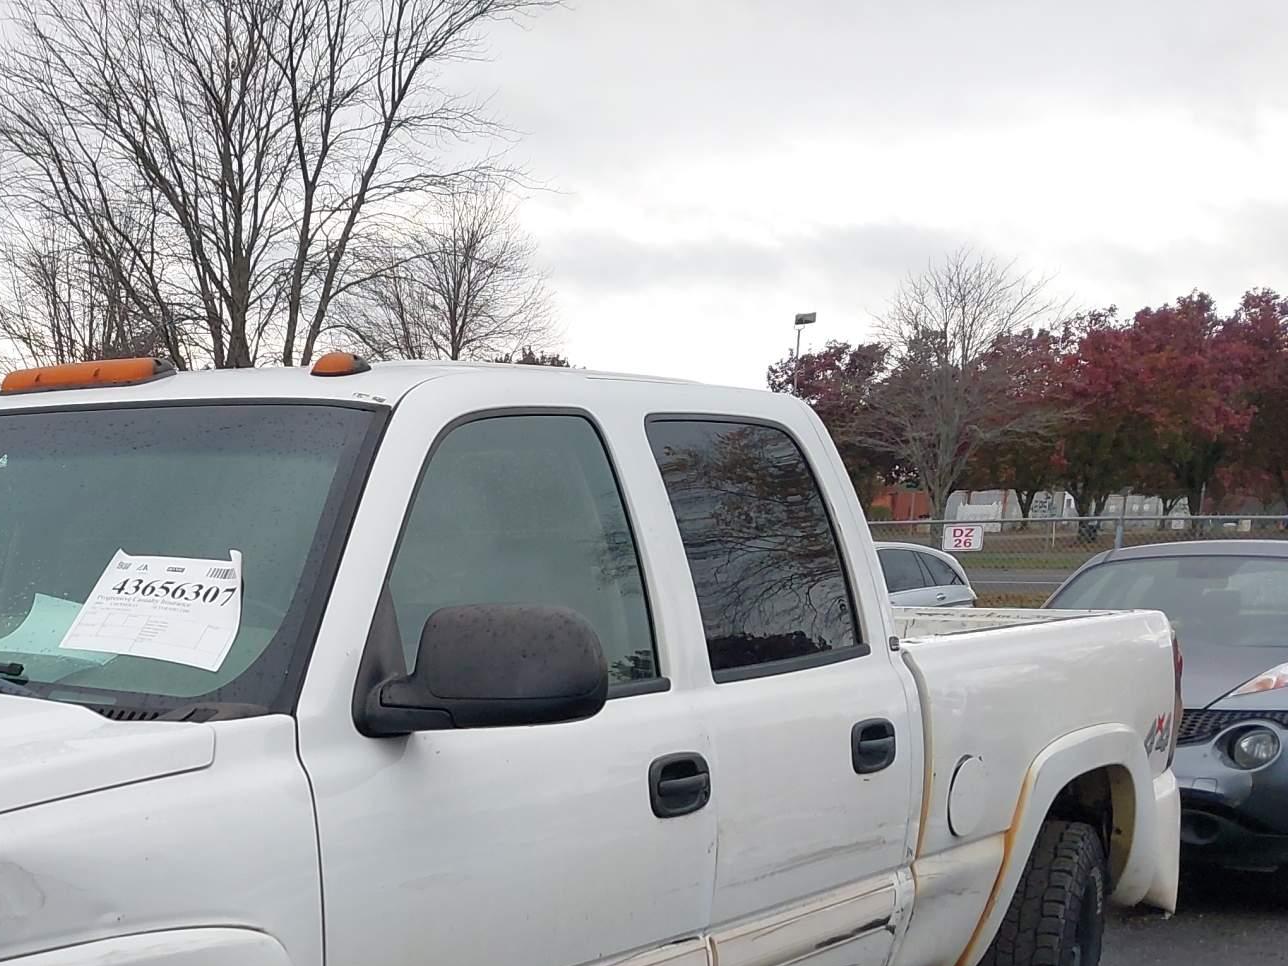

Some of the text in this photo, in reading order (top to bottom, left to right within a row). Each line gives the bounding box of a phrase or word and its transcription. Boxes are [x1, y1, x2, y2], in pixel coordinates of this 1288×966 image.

[952, 528, 975, 538] DZ
[953, 538, 972, 548] 26
[112, 578, 237, 607] 43656307
